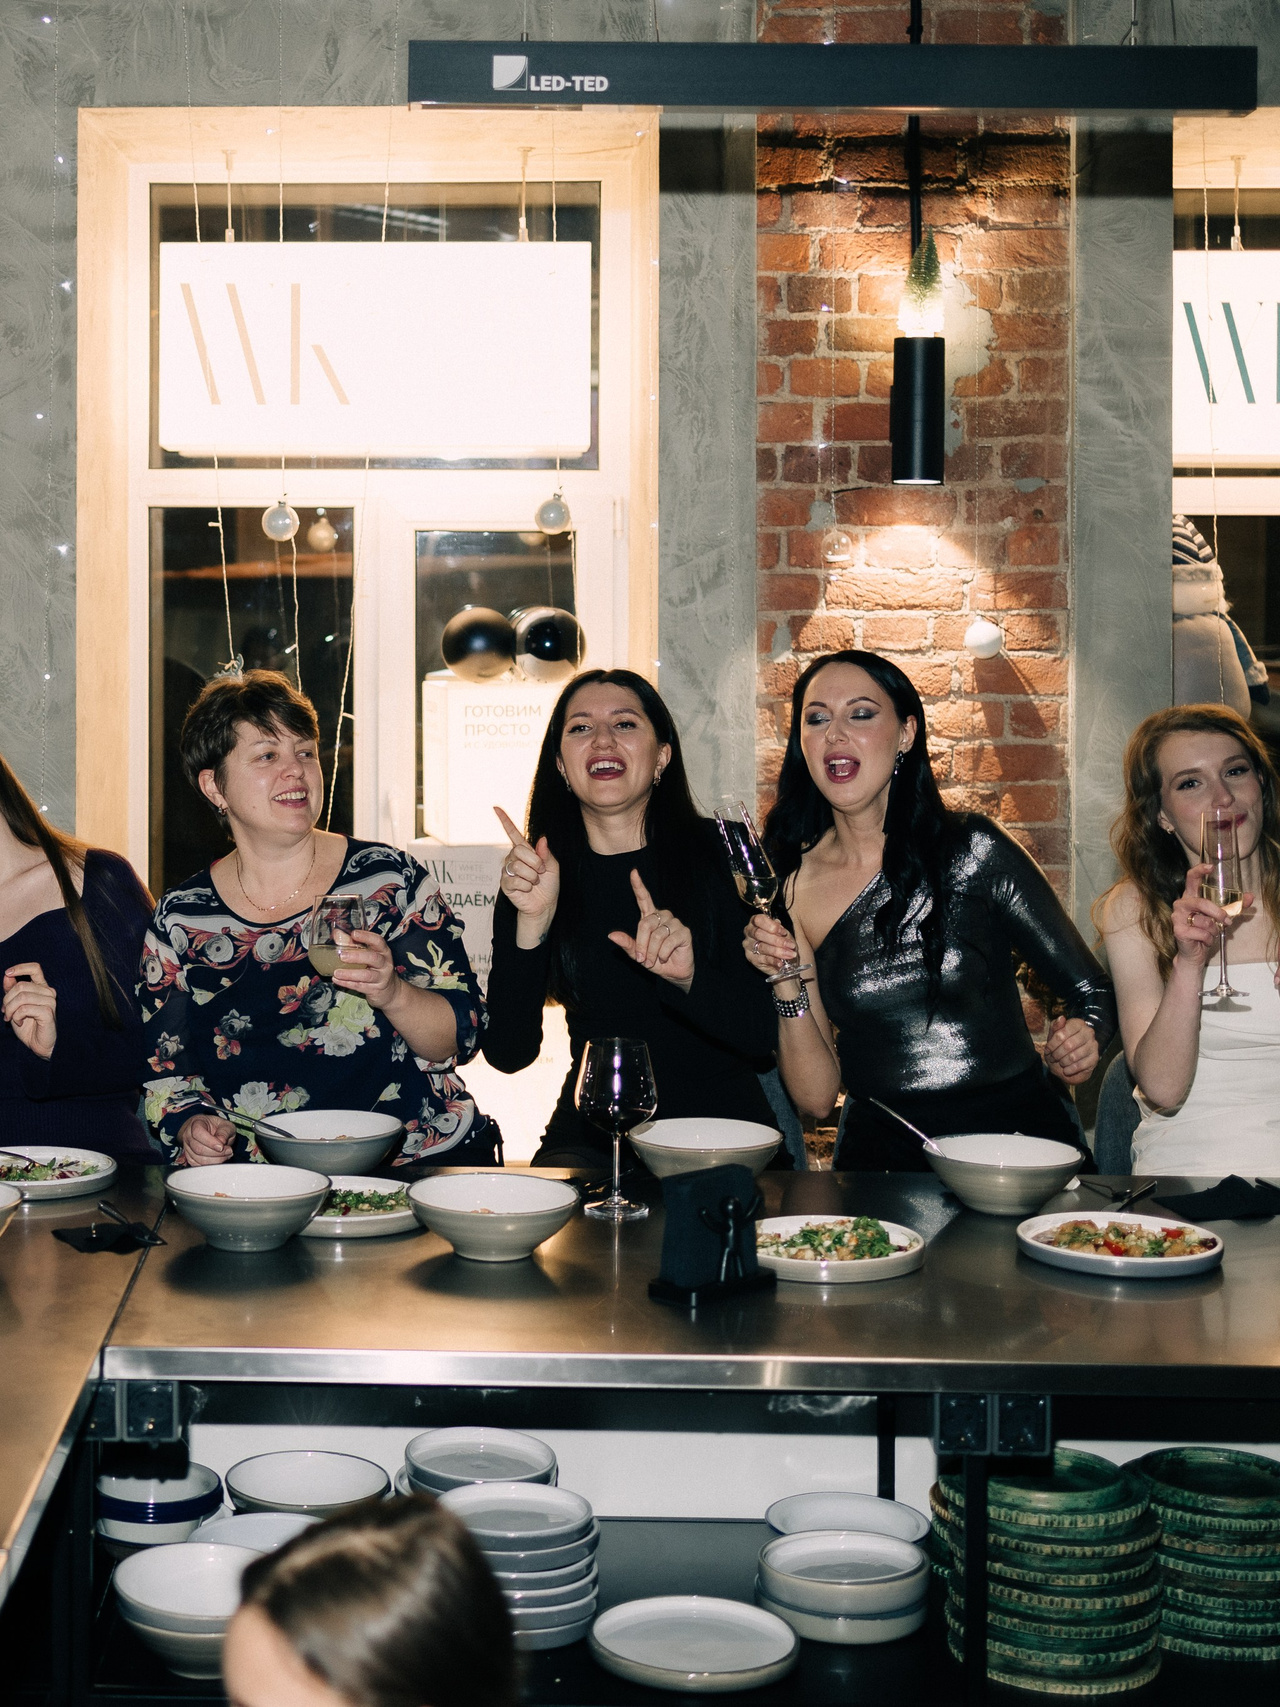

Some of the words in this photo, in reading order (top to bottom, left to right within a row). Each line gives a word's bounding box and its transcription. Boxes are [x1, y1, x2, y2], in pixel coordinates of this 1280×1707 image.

[530, 75, 609, 92] LED-TED
[464, 704, 542, 718] ГОТОВИМ
[464, 723, 531, 736] ПРОСТО
[458, 864, 484, 873] WHITE
[458, 873, 493, 883] KITCHEN
[444, 891, 496, 909] ЗДАЁМ
